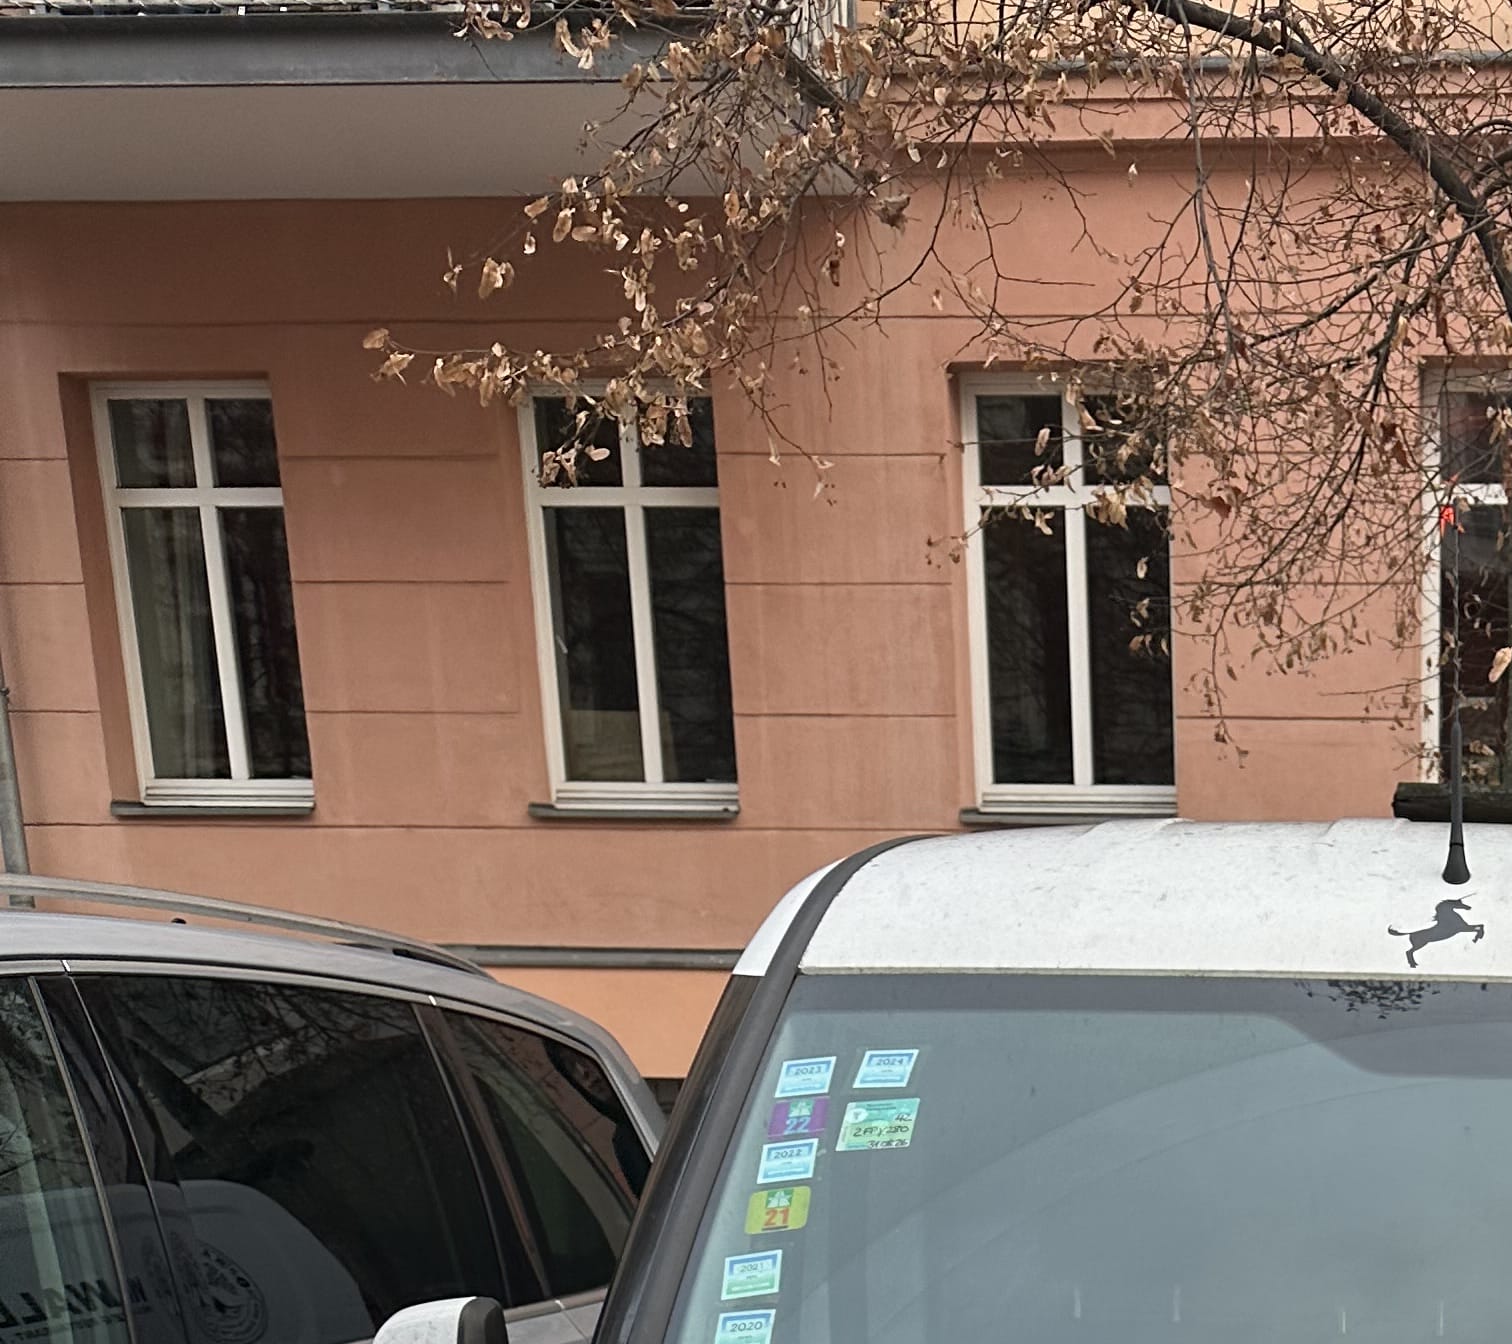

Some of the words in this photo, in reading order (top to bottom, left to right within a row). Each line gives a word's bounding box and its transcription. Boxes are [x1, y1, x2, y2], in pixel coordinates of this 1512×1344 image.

[783, 1116, 811, 1135] 22
[763, 1207, 790, 1227] 21
[729, 1320, 763, 1333] 2020
